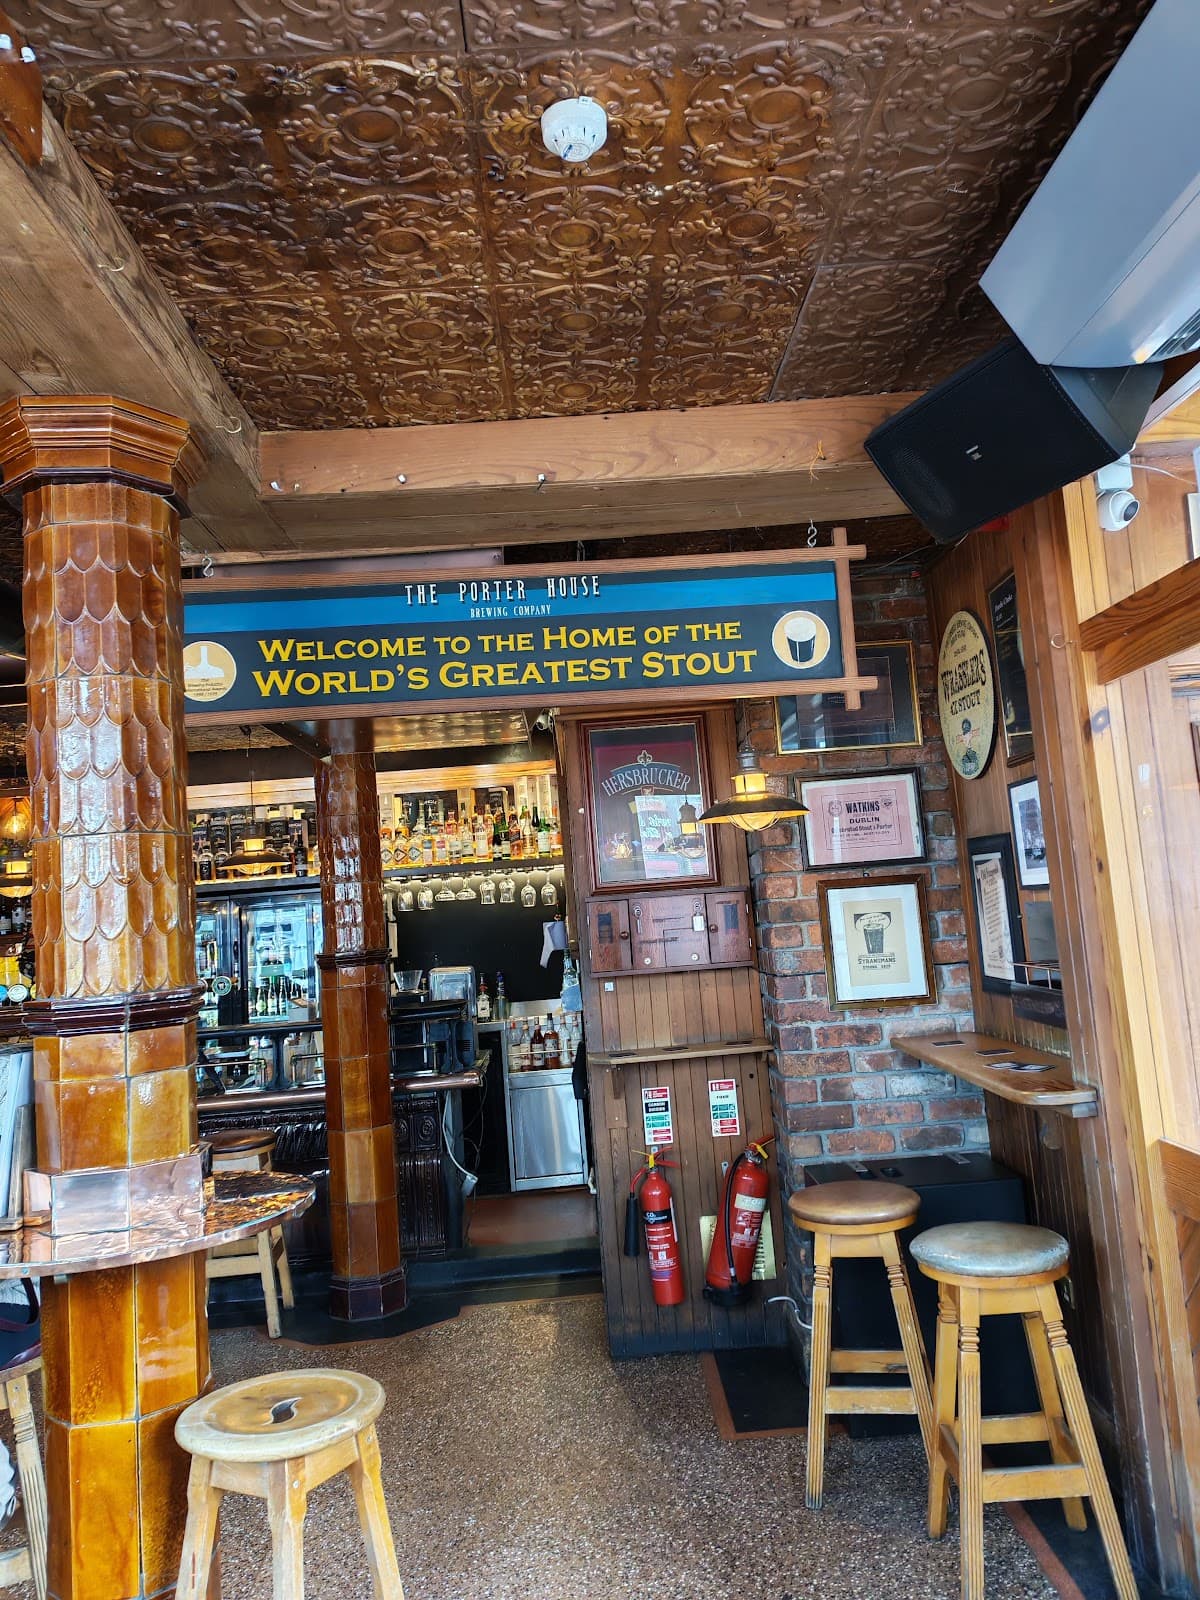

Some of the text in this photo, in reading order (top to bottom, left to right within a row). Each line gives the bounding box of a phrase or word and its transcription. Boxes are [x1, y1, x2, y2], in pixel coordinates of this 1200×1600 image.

[404, 575, 600, 606] THE PORTER HOUSE
[470, 604, 551, 619] BREWING COMPANY
[257, 621, 742, 663] WELCOME TO THE HOME OF THE
[252, 663, 430, 697] WORLD'S
[438, 656, 633, 688] GREATEST
[641, 649, 757, 678] STOUT
[601, 767, 692, 797] HERSBRUCKER
[845, 800, 881, 814] WATKINS
[849, 816, 880, 825] DUBLIN
